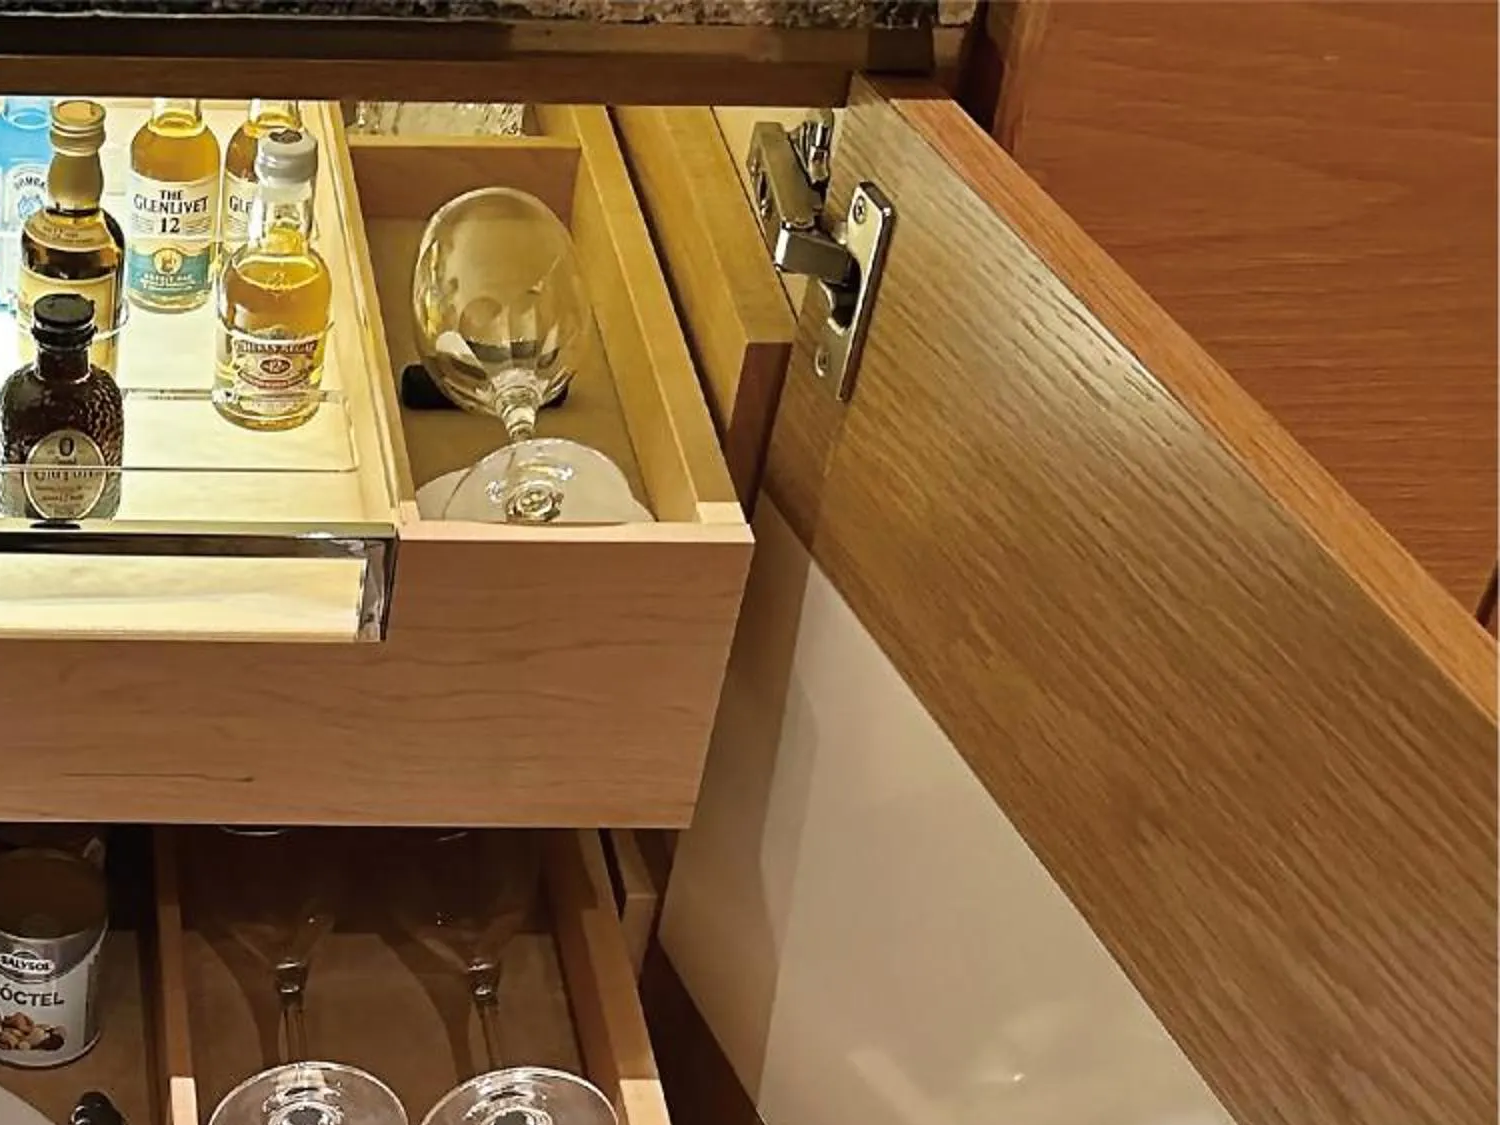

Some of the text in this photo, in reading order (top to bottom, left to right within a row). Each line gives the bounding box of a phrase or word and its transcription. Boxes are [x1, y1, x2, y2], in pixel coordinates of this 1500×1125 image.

[161, 189, 182, 201] THE
[133, 193, 208, 214] GLENLIVET
[161, 217, 180, 233] 12
